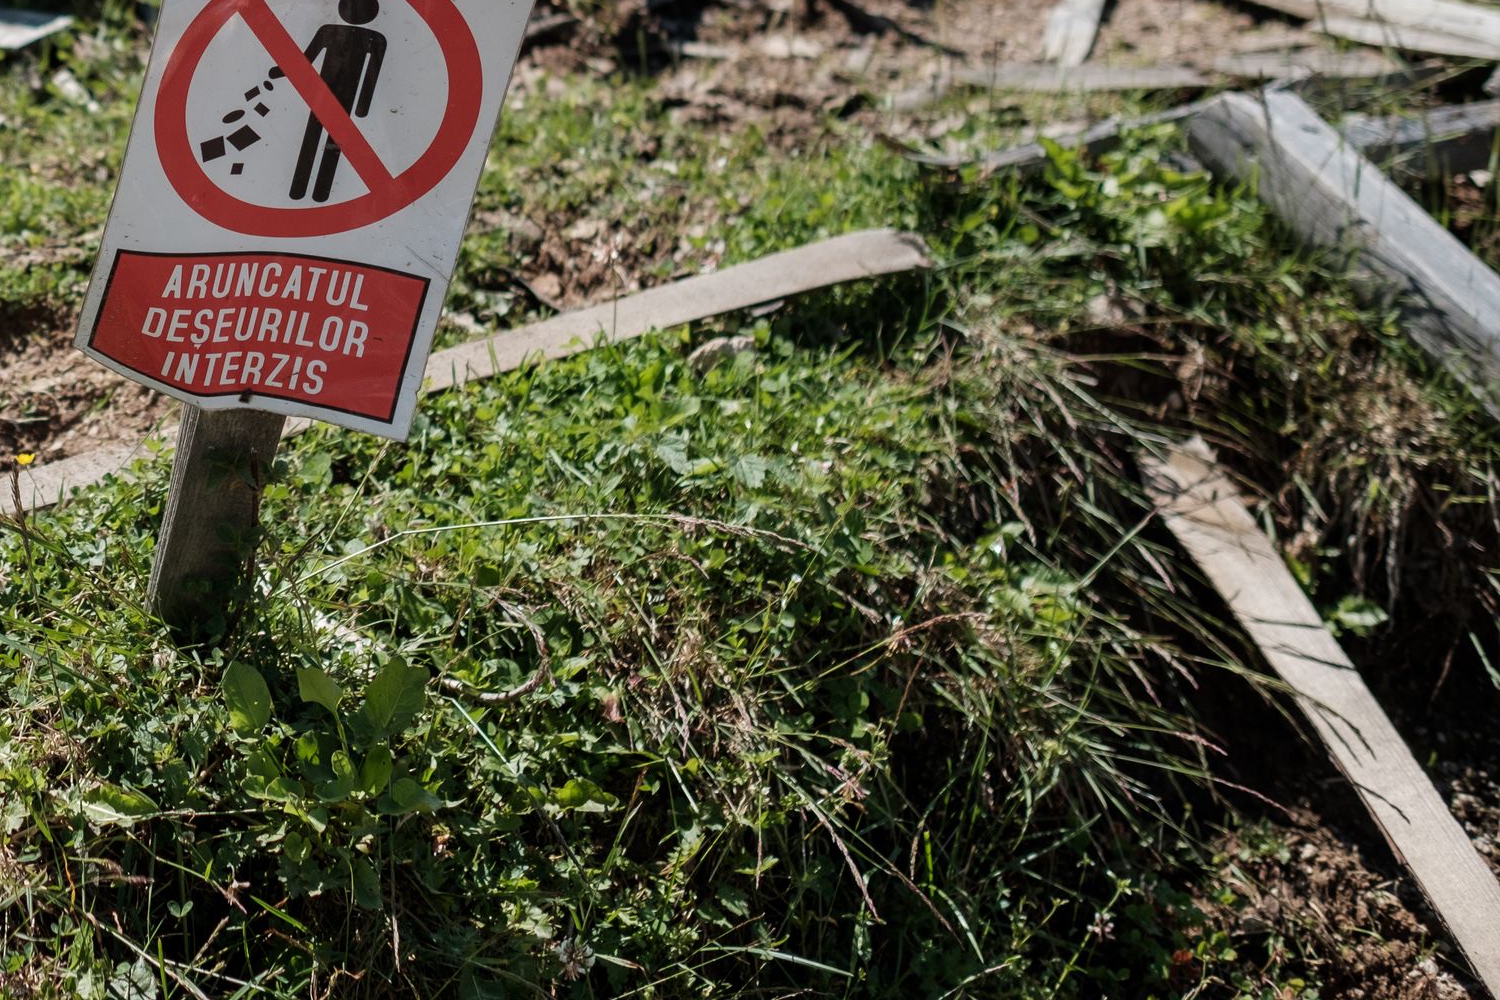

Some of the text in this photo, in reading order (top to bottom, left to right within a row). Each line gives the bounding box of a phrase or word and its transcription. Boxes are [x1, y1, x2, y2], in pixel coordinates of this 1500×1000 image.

[161, 262, 370, 312] ARUNCATUL
[141, 306, 370, 358] DEȘEURILOR
[160, 351, 328, 395] INTERZIS
